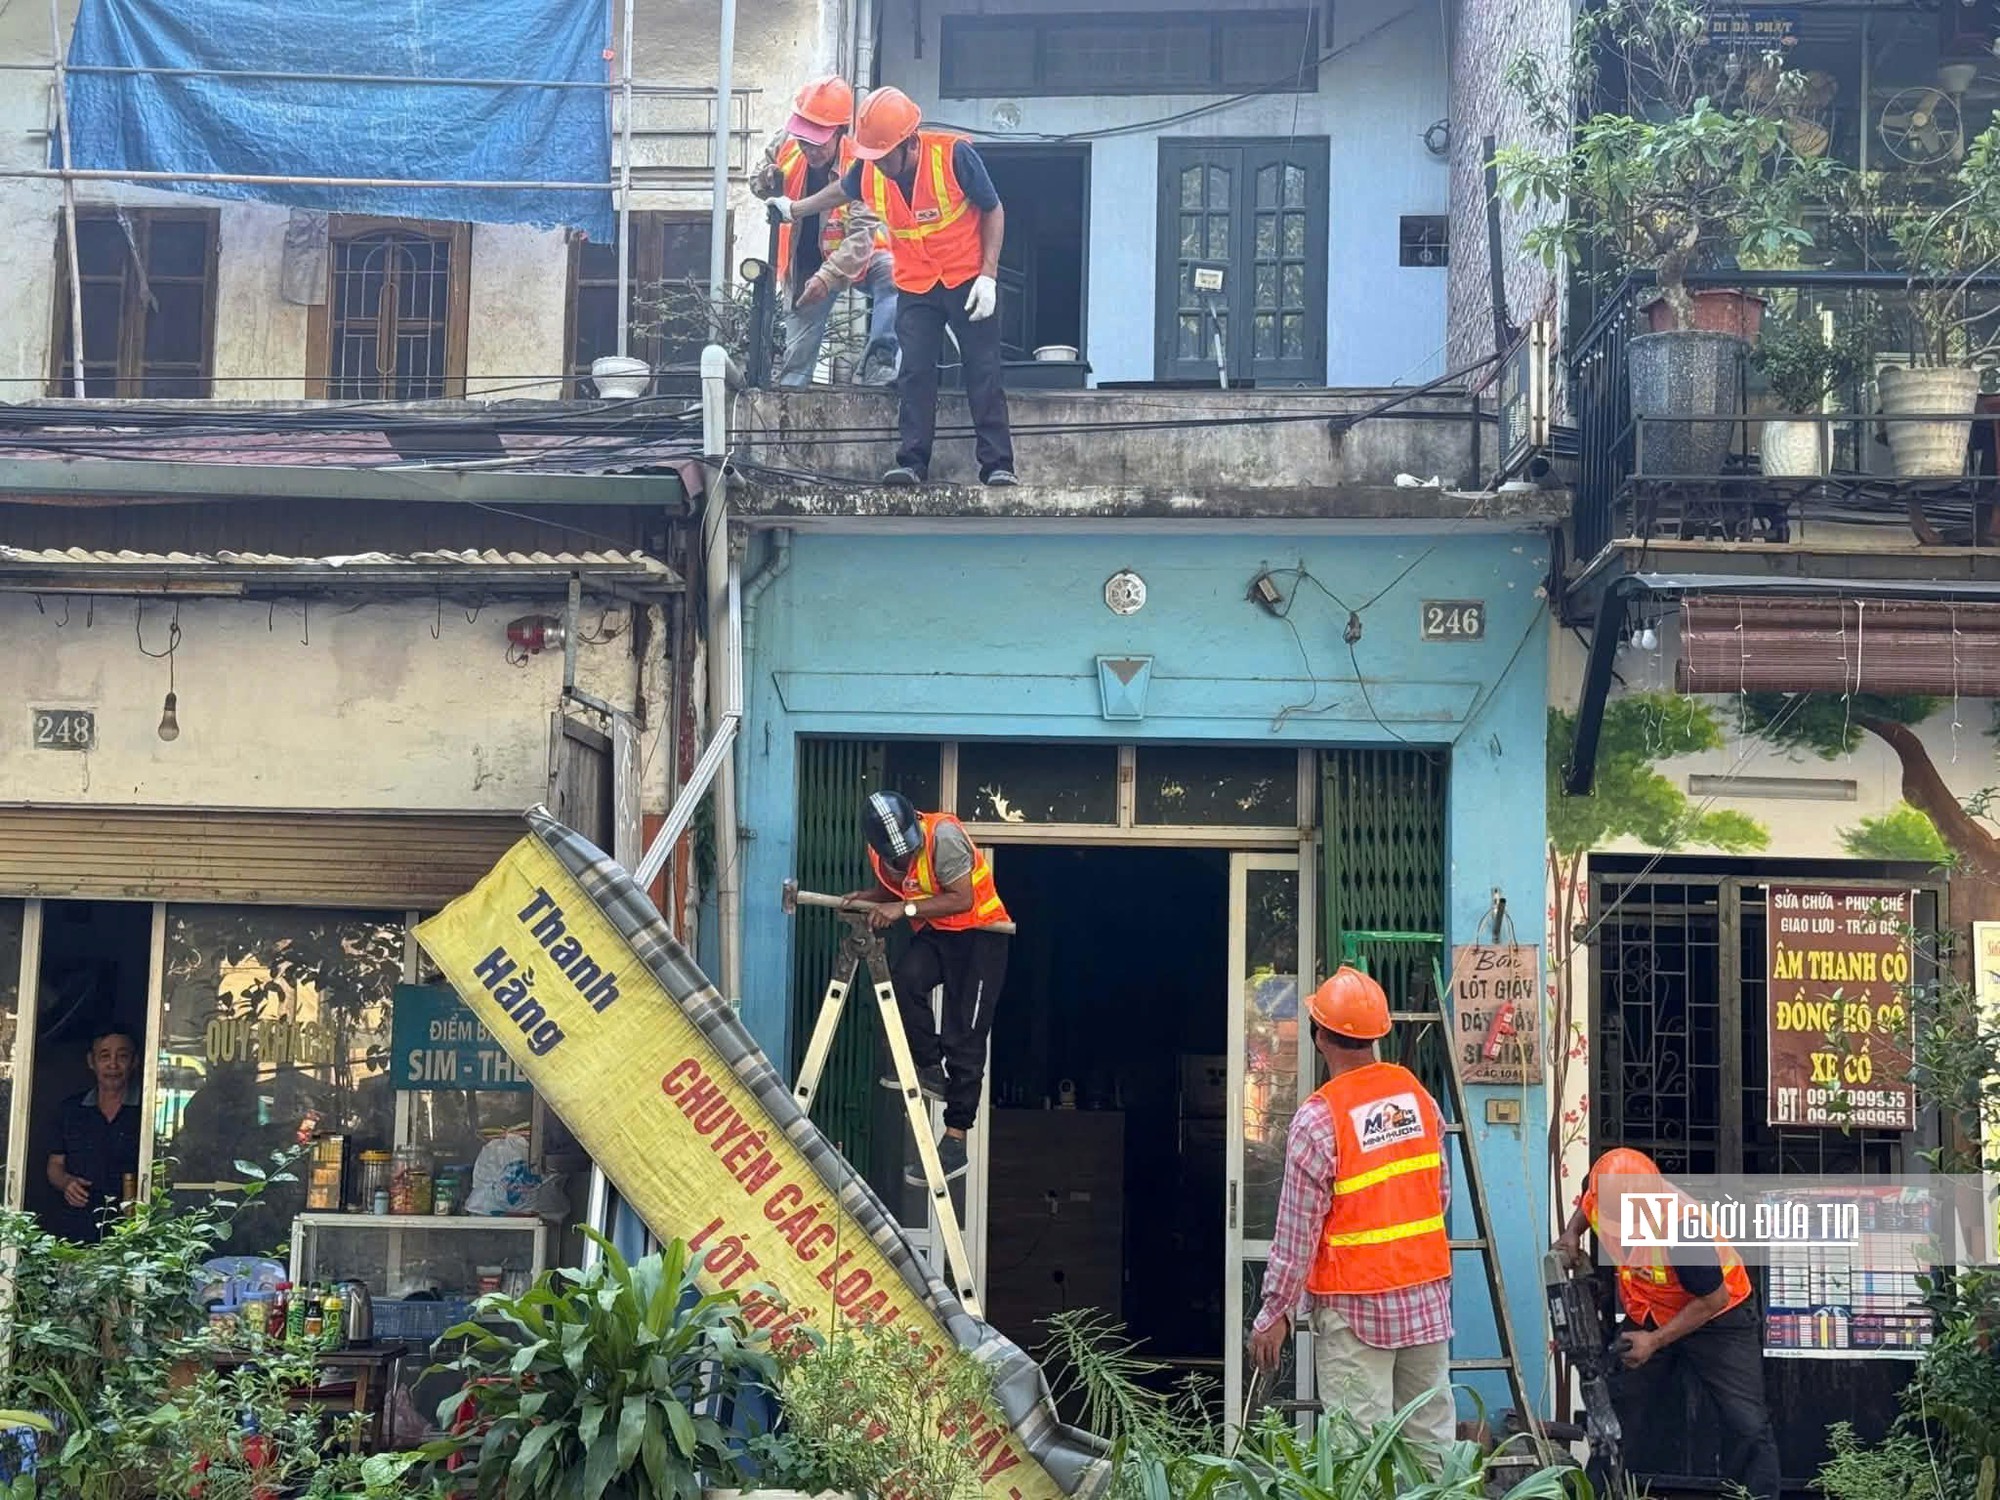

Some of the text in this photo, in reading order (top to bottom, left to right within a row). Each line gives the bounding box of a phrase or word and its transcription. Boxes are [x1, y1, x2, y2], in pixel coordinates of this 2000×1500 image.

[1428, 607, 1479, 634] 246
[37, 716, 90, 743] 248
[1774, 888, 1799, 909] SỬA
[1781, 917, 1809, 932] GIAO
[517, 886, 620, 1015] Thanh
[1773, 940, 1804, 980] ÂM
[1807, 950, 1877, 981] THANH
[473, 945, 566, 1057] Hằng
[1459, 974, 1488, 1000] LÓT
[1776, 986, 1836, 1032] ĐỒNG
[429, 1012, 472, 1041] ĐIỂM
[408, 1049, 457, 1082] SIM
[1810, 1038, 1873, 1084] XE CỔ
[661, 1058, 783, 1196] CHUYÊN
[763, 1183, 836, 1262] CÁC
